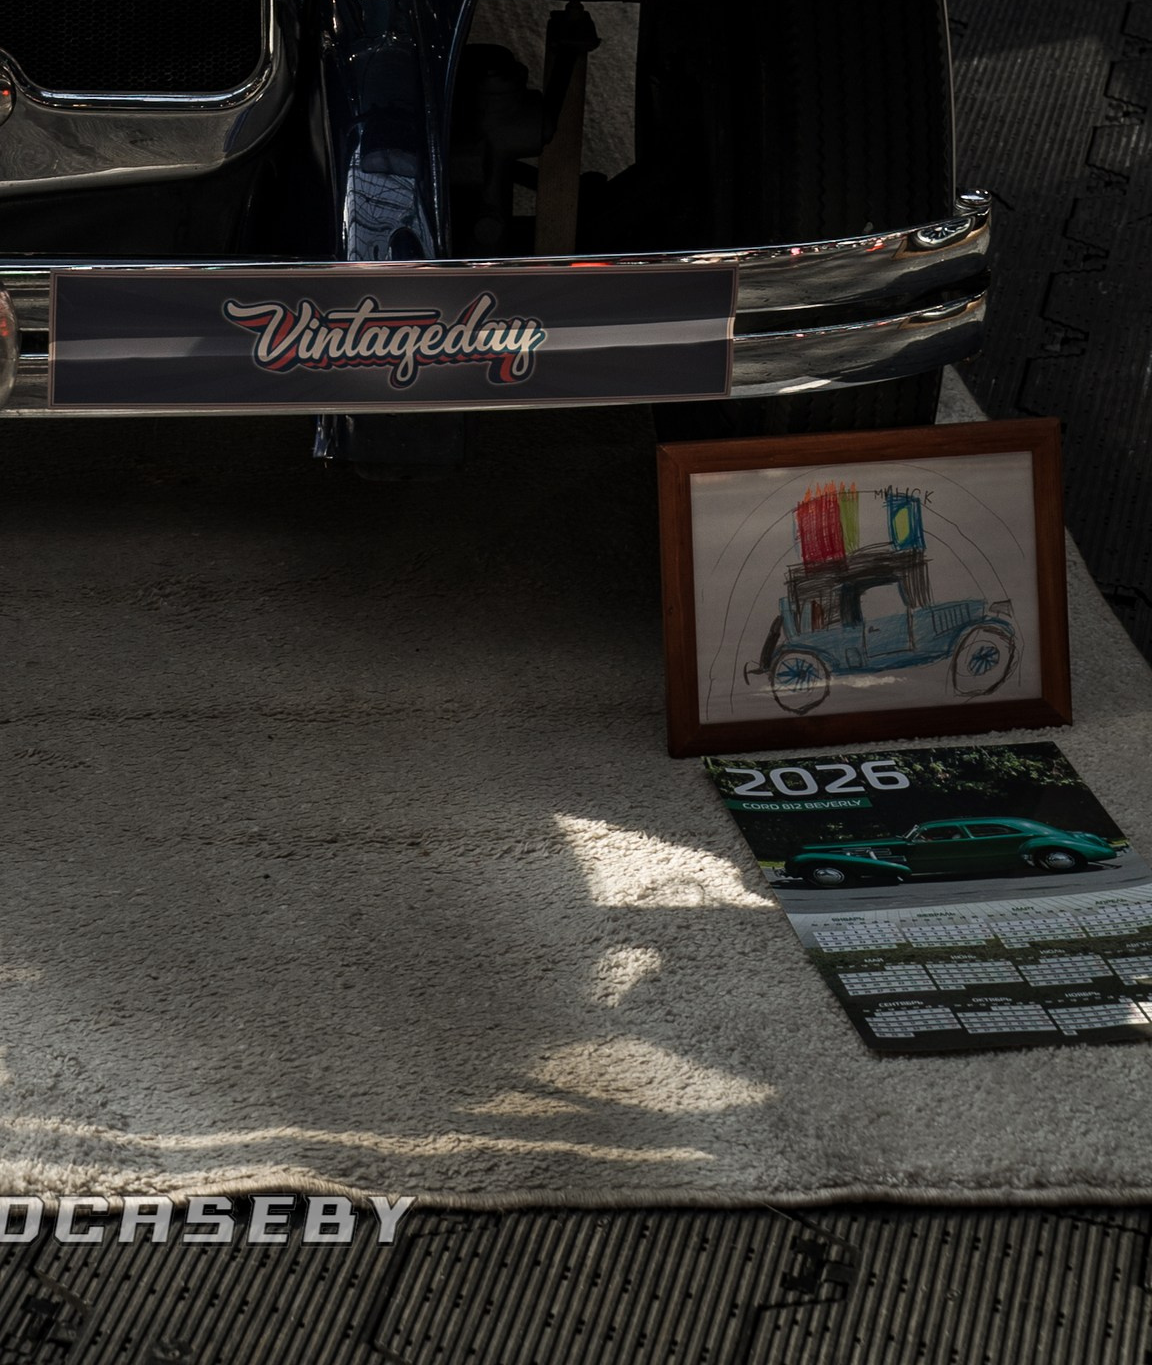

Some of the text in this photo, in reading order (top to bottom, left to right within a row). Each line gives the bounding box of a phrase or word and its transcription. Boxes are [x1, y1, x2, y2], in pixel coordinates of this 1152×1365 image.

[225, 292, 546, 386] Vintageday
[724, 760, 910, 797] 2026
[742, 799, 862, 810] CORD 812 BEVERLY
